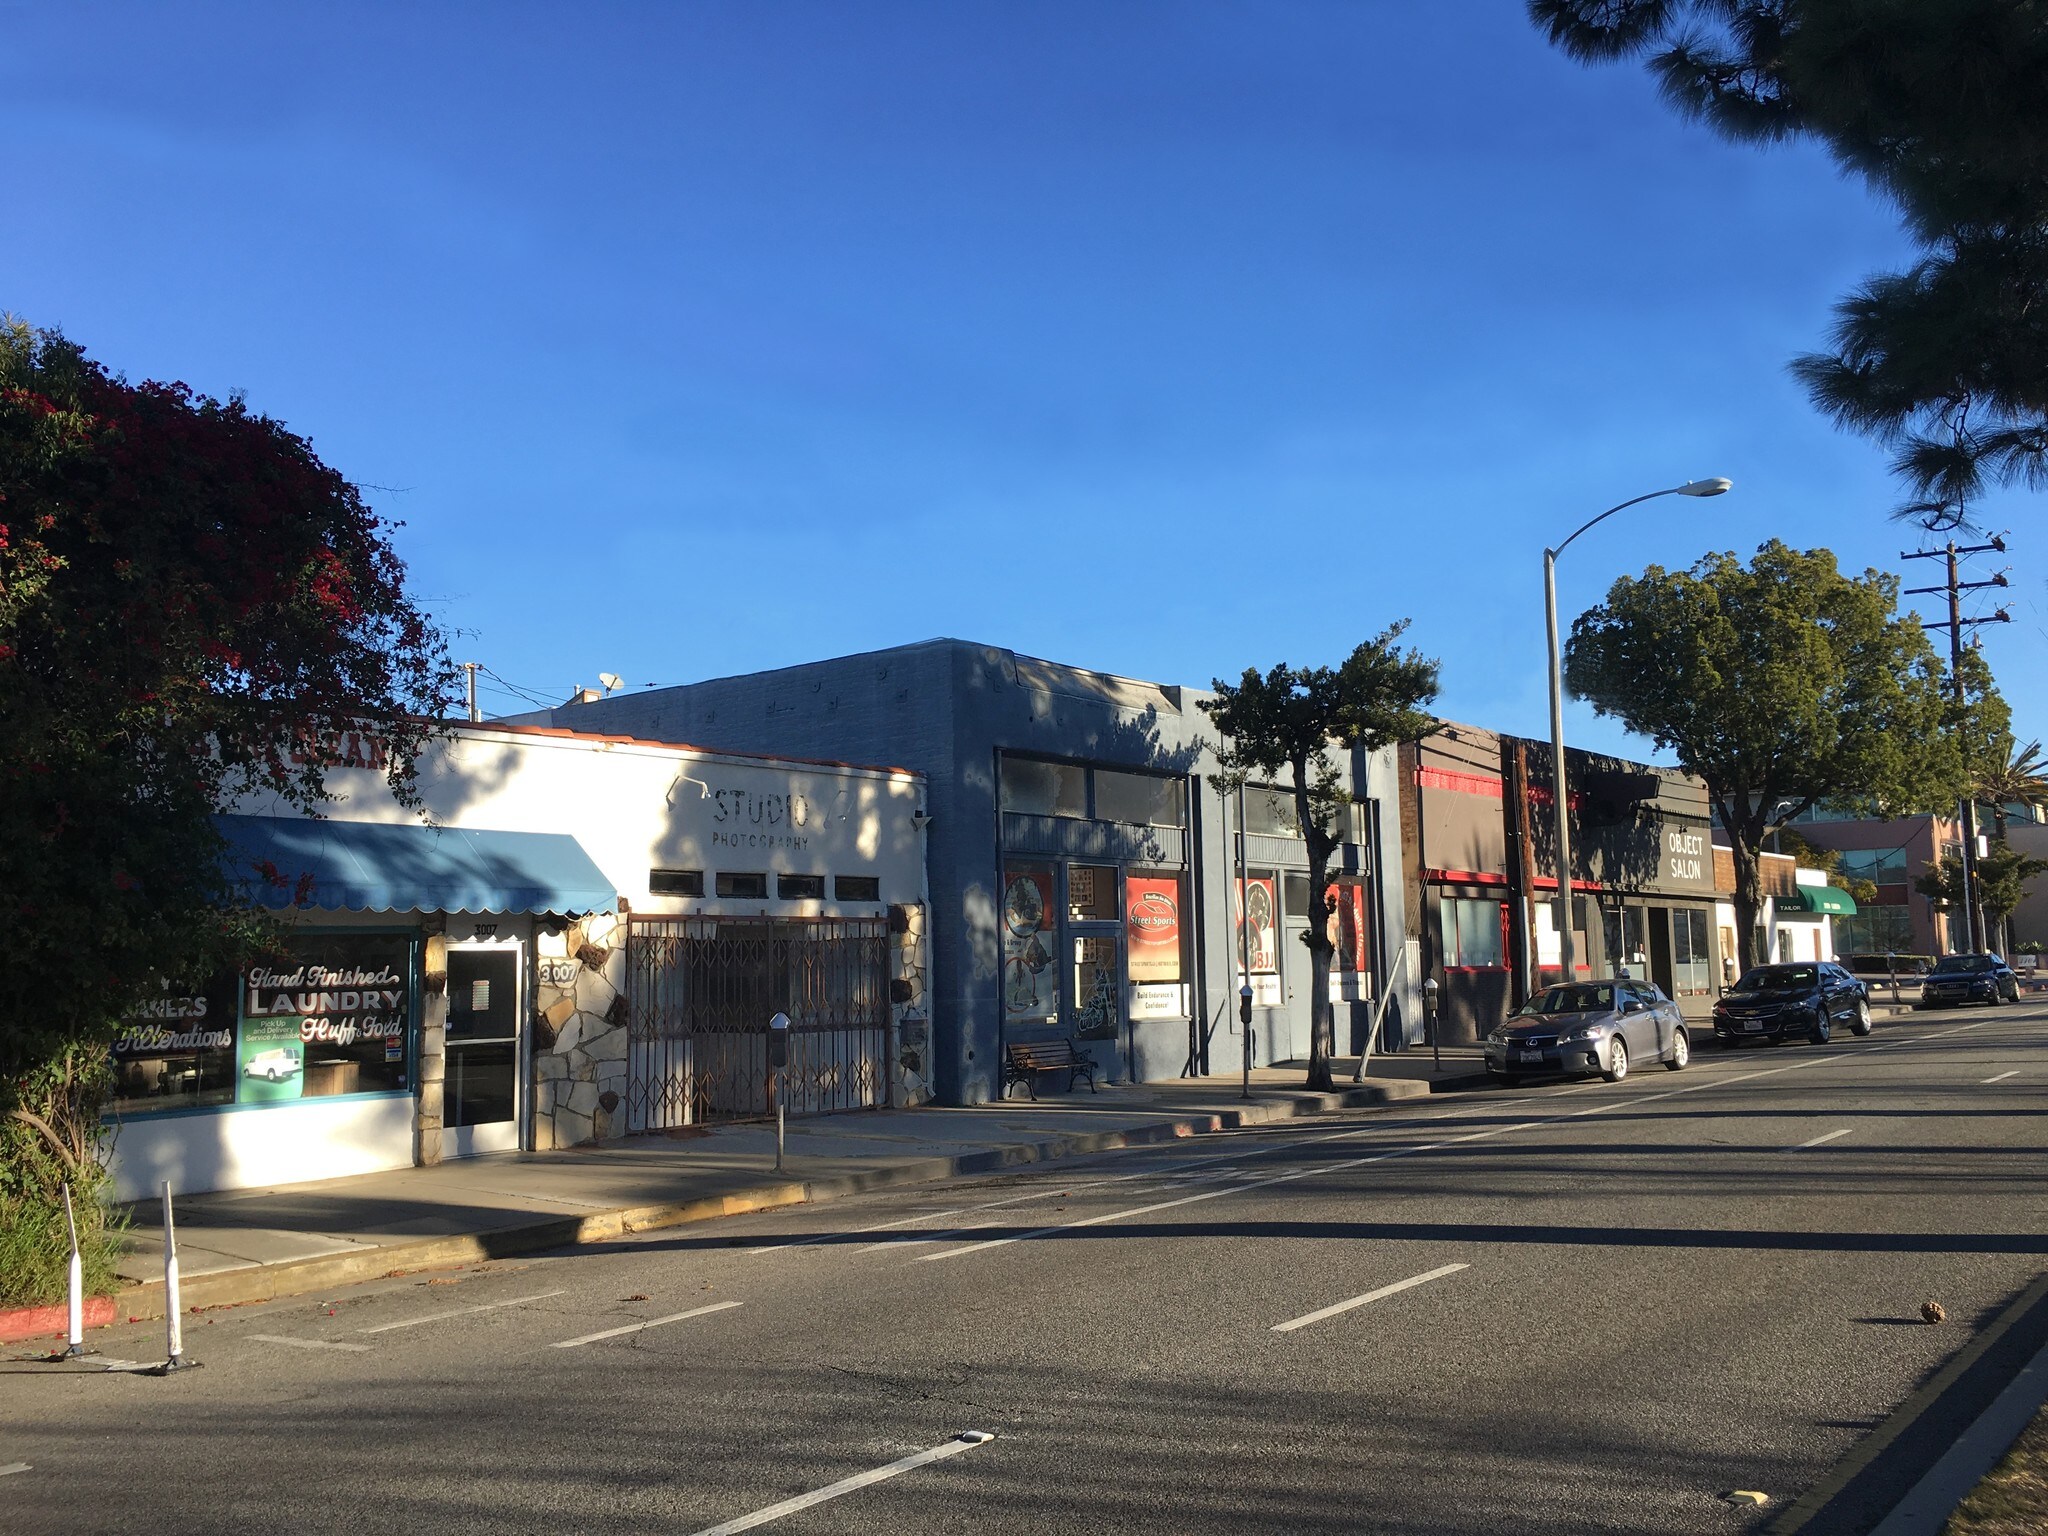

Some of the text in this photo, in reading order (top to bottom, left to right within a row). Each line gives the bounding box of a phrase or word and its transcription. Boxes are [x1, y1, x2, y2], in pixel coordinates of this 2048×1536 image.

[714, 788, 809, 827] STUDIO
[712, 831, 808, 850] PHOTOGRAPHY
[1669, 832, 1703, 856] OBJECT
[1671, 858, 1701, 880] SALON
[474, 923, 498, 936] 3007
[1130, 916, 1176, 927] Street Sports
[1256, 951, 1274, 969] BJJ
[249, 965, 400, 989] Hand Finished
[541, 962, 577, 981] 3007
[250, 989, 403, 1015] LAUNDRY
[253, 1026, 294, 1035] and Delivery
[260, 1020, 286, 1028] Pick Up
[300, 1015, 403, 1047] Fluff & Fold
[115, 1022, 231, 1052] Alterations
[245, 1034, 271, 1042] Service
